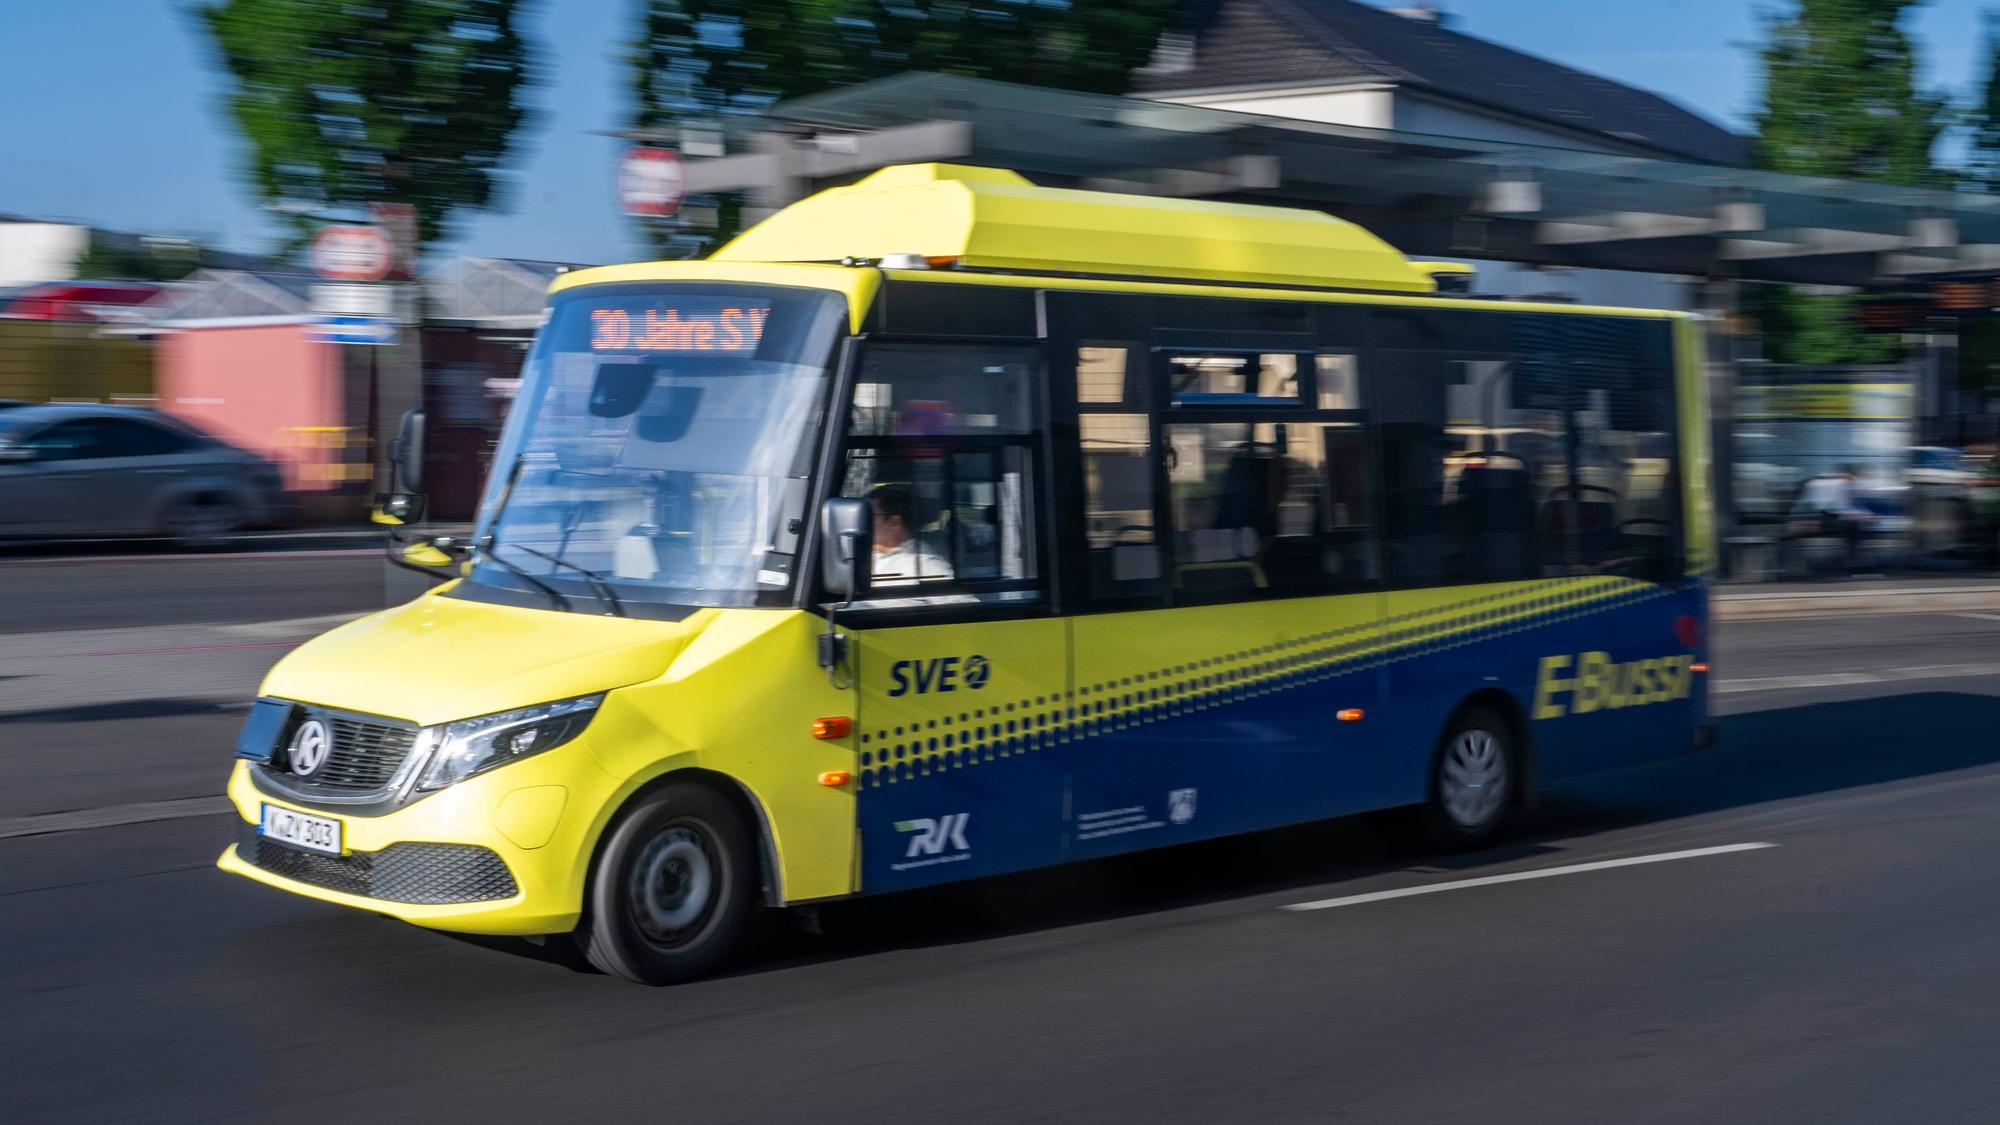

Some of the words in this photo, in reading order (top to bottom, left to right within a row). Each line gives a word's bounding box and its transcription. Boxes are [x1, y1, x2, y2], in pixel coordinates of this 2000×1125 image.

[591, 309, 630, 349] 30
[634, 309, 716, 350] Jahre
[720, 308, 743, 350] S
[887, 656, 961, 698] SVE
[304, 819, 333, 848] 303
